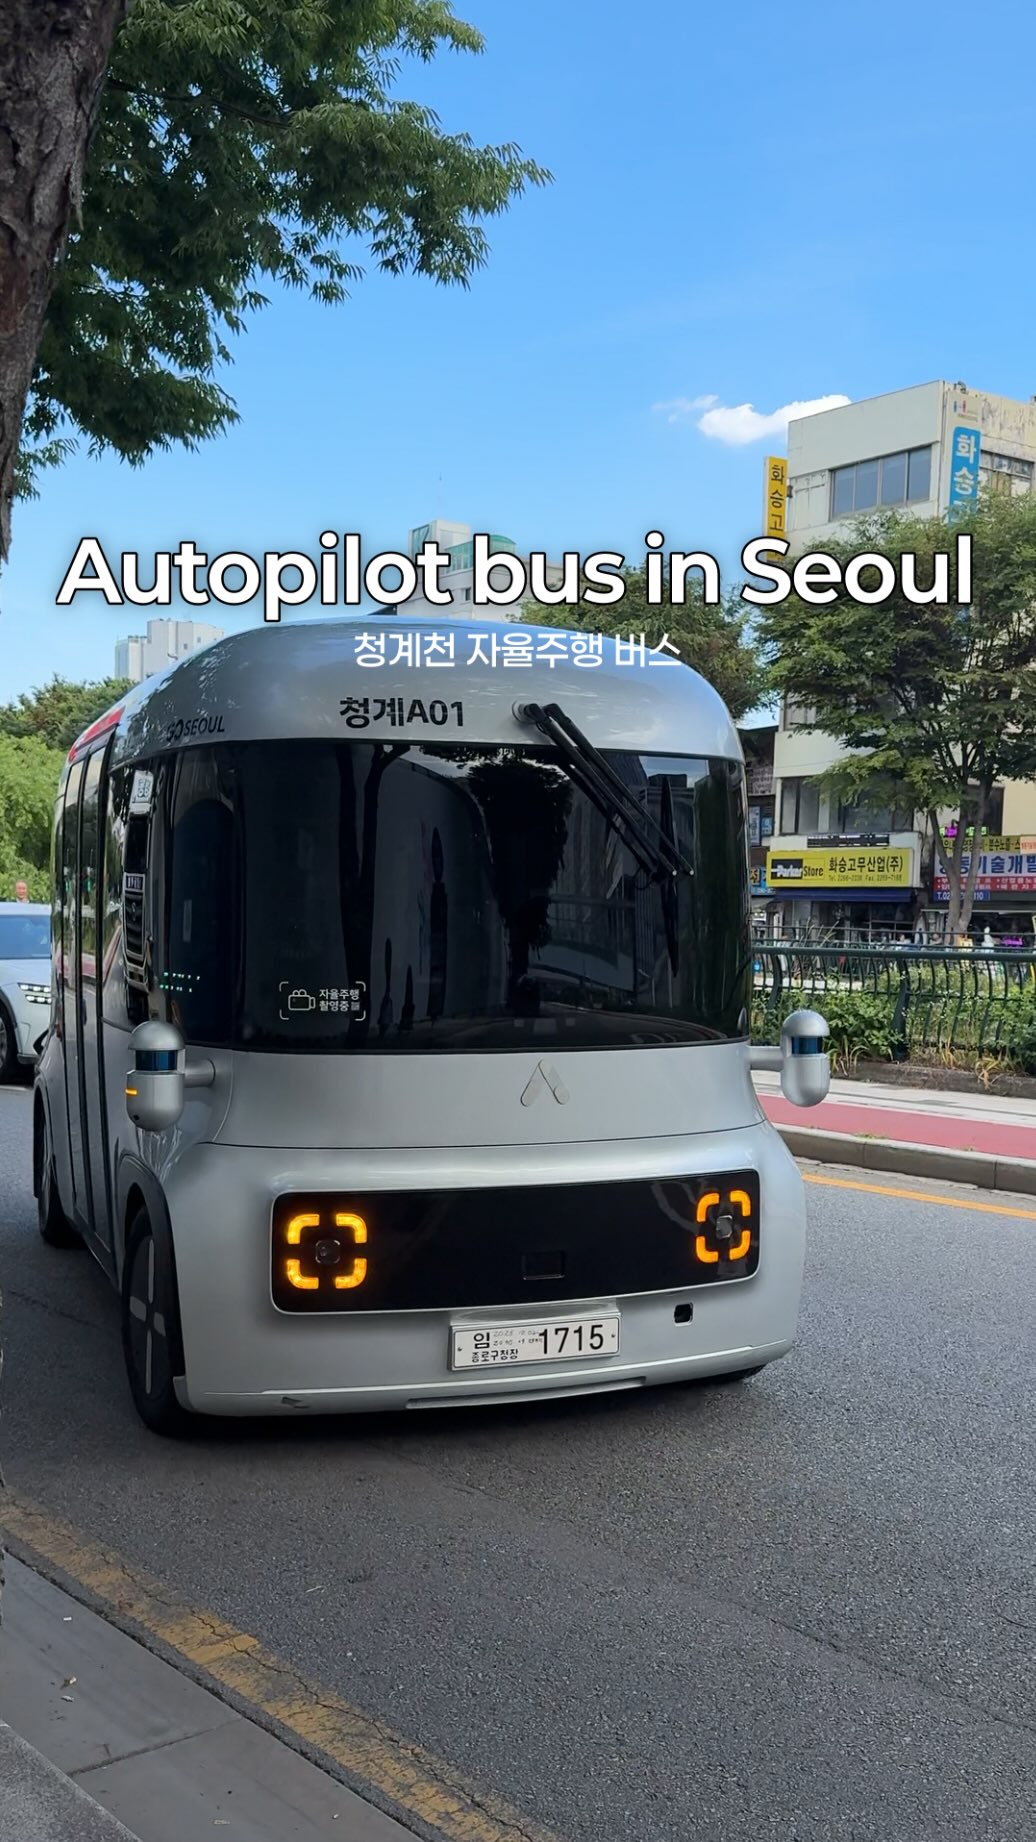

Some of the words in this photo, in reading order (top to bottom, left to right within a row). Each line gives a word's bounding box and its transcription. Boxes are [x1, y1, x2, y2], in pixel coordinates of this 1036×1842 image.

[339, 697, 464, 729] 청계A01
[829, 856, 903, 873] 화승고무산업(주)
[939, 855, 1036, 875] 동기술개발
[319, 988, 360, 1001] 자율주행
[319, 1000, 350, 1012] 촬영중
[473, 1332, 490, 1350] 임
[539, 1324, 604, 1355] 1715
[472, 1348, 519, 1364] 종로구청장
